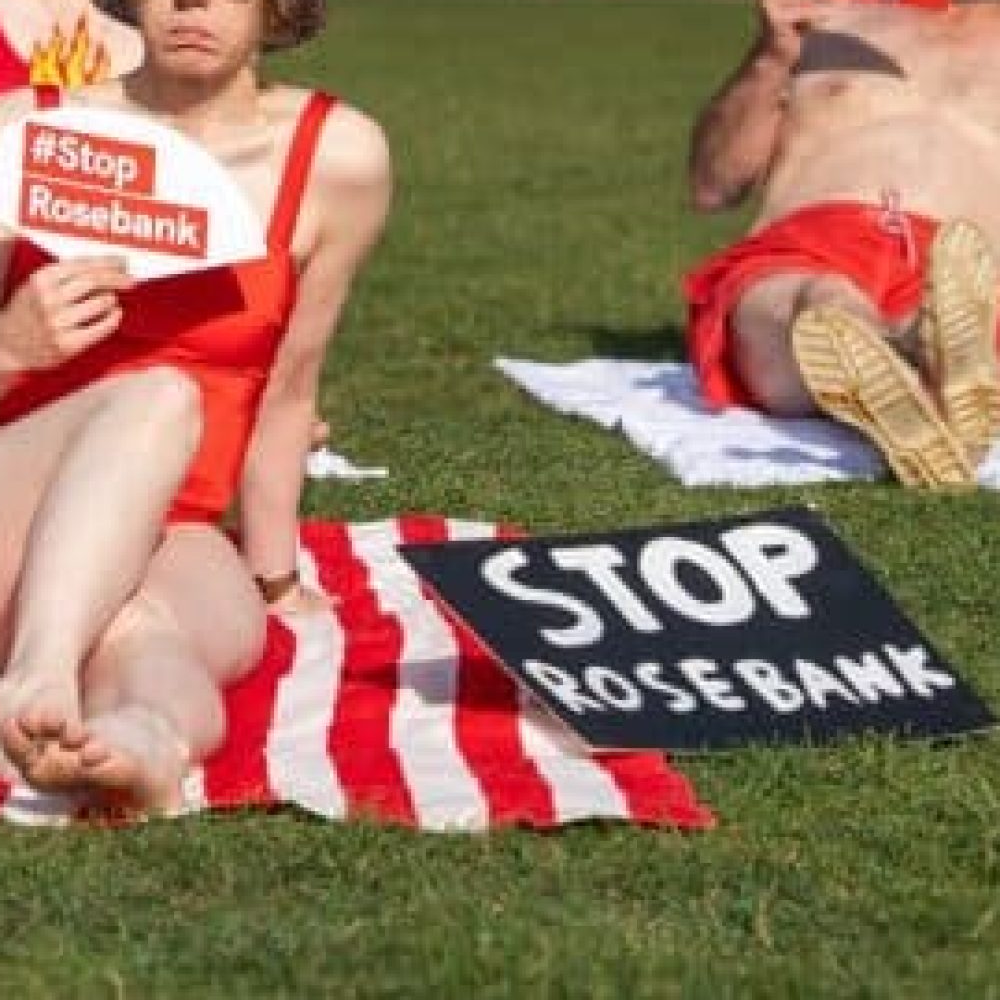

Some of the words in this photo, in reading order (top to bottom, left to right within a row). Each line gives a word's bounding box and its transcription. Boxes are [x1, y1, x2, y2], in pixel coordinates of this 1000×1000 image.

[28, 130, 138, 190] #Stop
[28, 184, 199, 247] Rosebank
[479, 522, 821, 648] STOP
[520, 642, 957, 715] ROSEBANK
